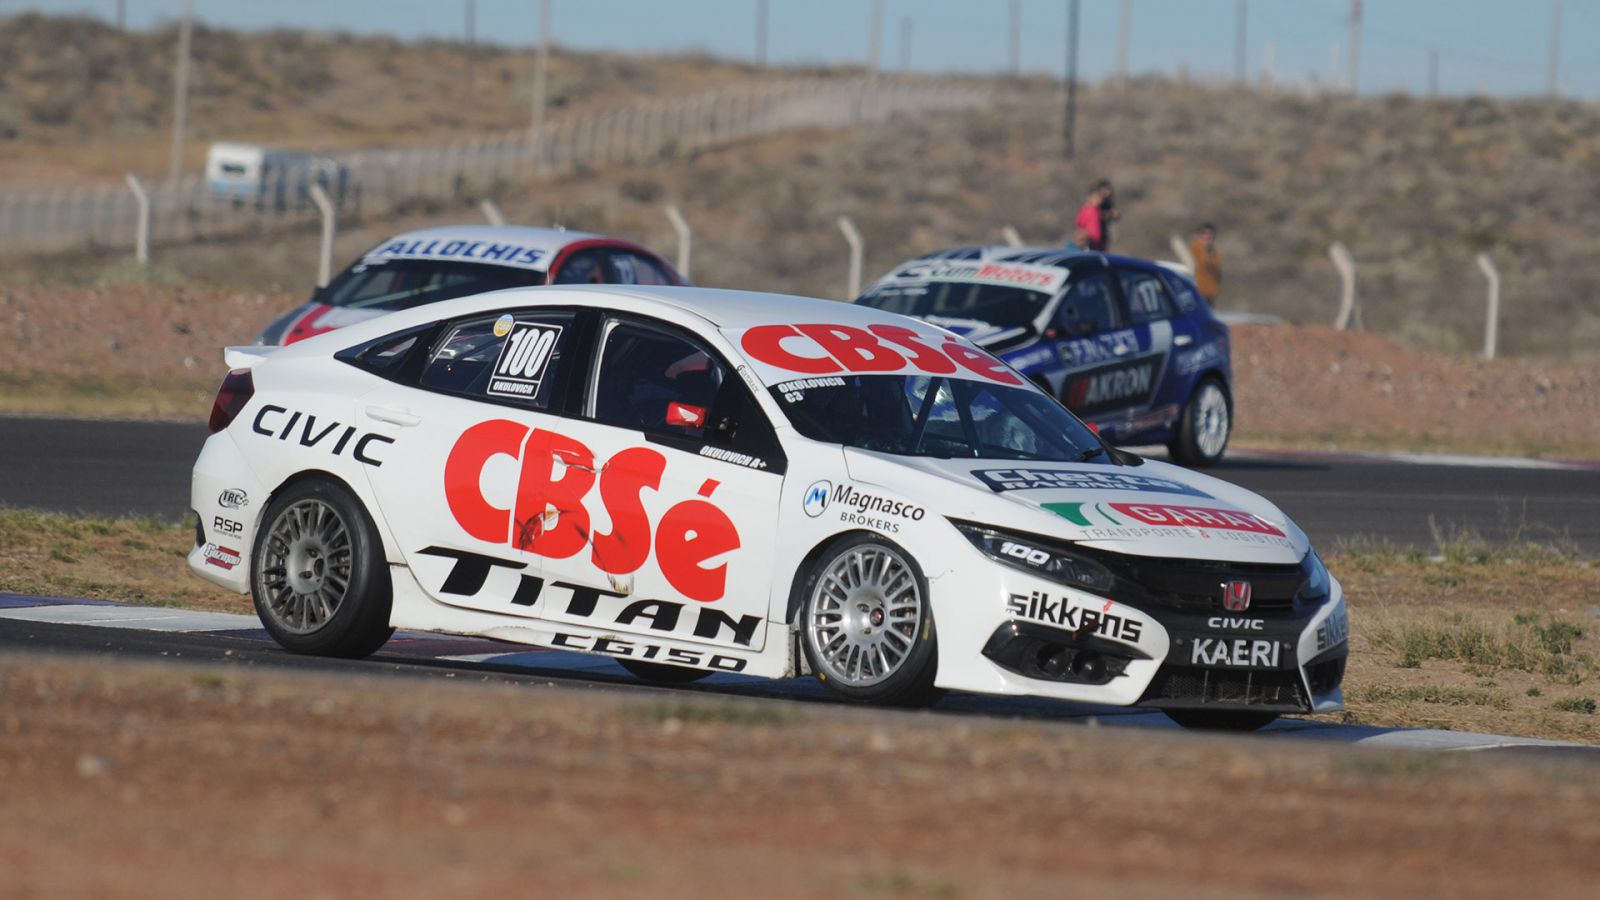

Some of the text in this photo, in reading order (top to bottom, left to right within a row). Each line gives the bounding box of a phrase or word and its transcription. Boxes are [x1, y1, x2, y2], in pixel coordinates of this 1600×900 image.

[499, 327, 556, 378] 100
[741, 323, 1024, 386] CBSé
[493, 381, 534, 395] OKULOVICH
[777, 377, 846, 393] OKULOVICH
[1086, 364, 1152, 404] AKRON
[784, 391, 804, 403] C3
[252, 404, 395, 467] CIVIC
[699, 445, 767, 469] OKULOVICH A+
[1002, 481, 1140, 491] RACING
[444, 419, 741, 602] CBSé
[832, 484, 925, 521] Magnasco
[214, 516, 243, 533] RSP
[840, 512, 901, 533] BROKERS
[1128, 505, 1269, 531] GARAY
[1080, 529, 1196, 541] TRANSPORTE
[1000, 541, 1050, 565] 100
[1006, 591, 1143, 643] sikkens
[1208, 617, 1264, 630] CIVIC
[551, 632, 748, 673] CG150
[1191, 638, 1280, 667] KAERI
